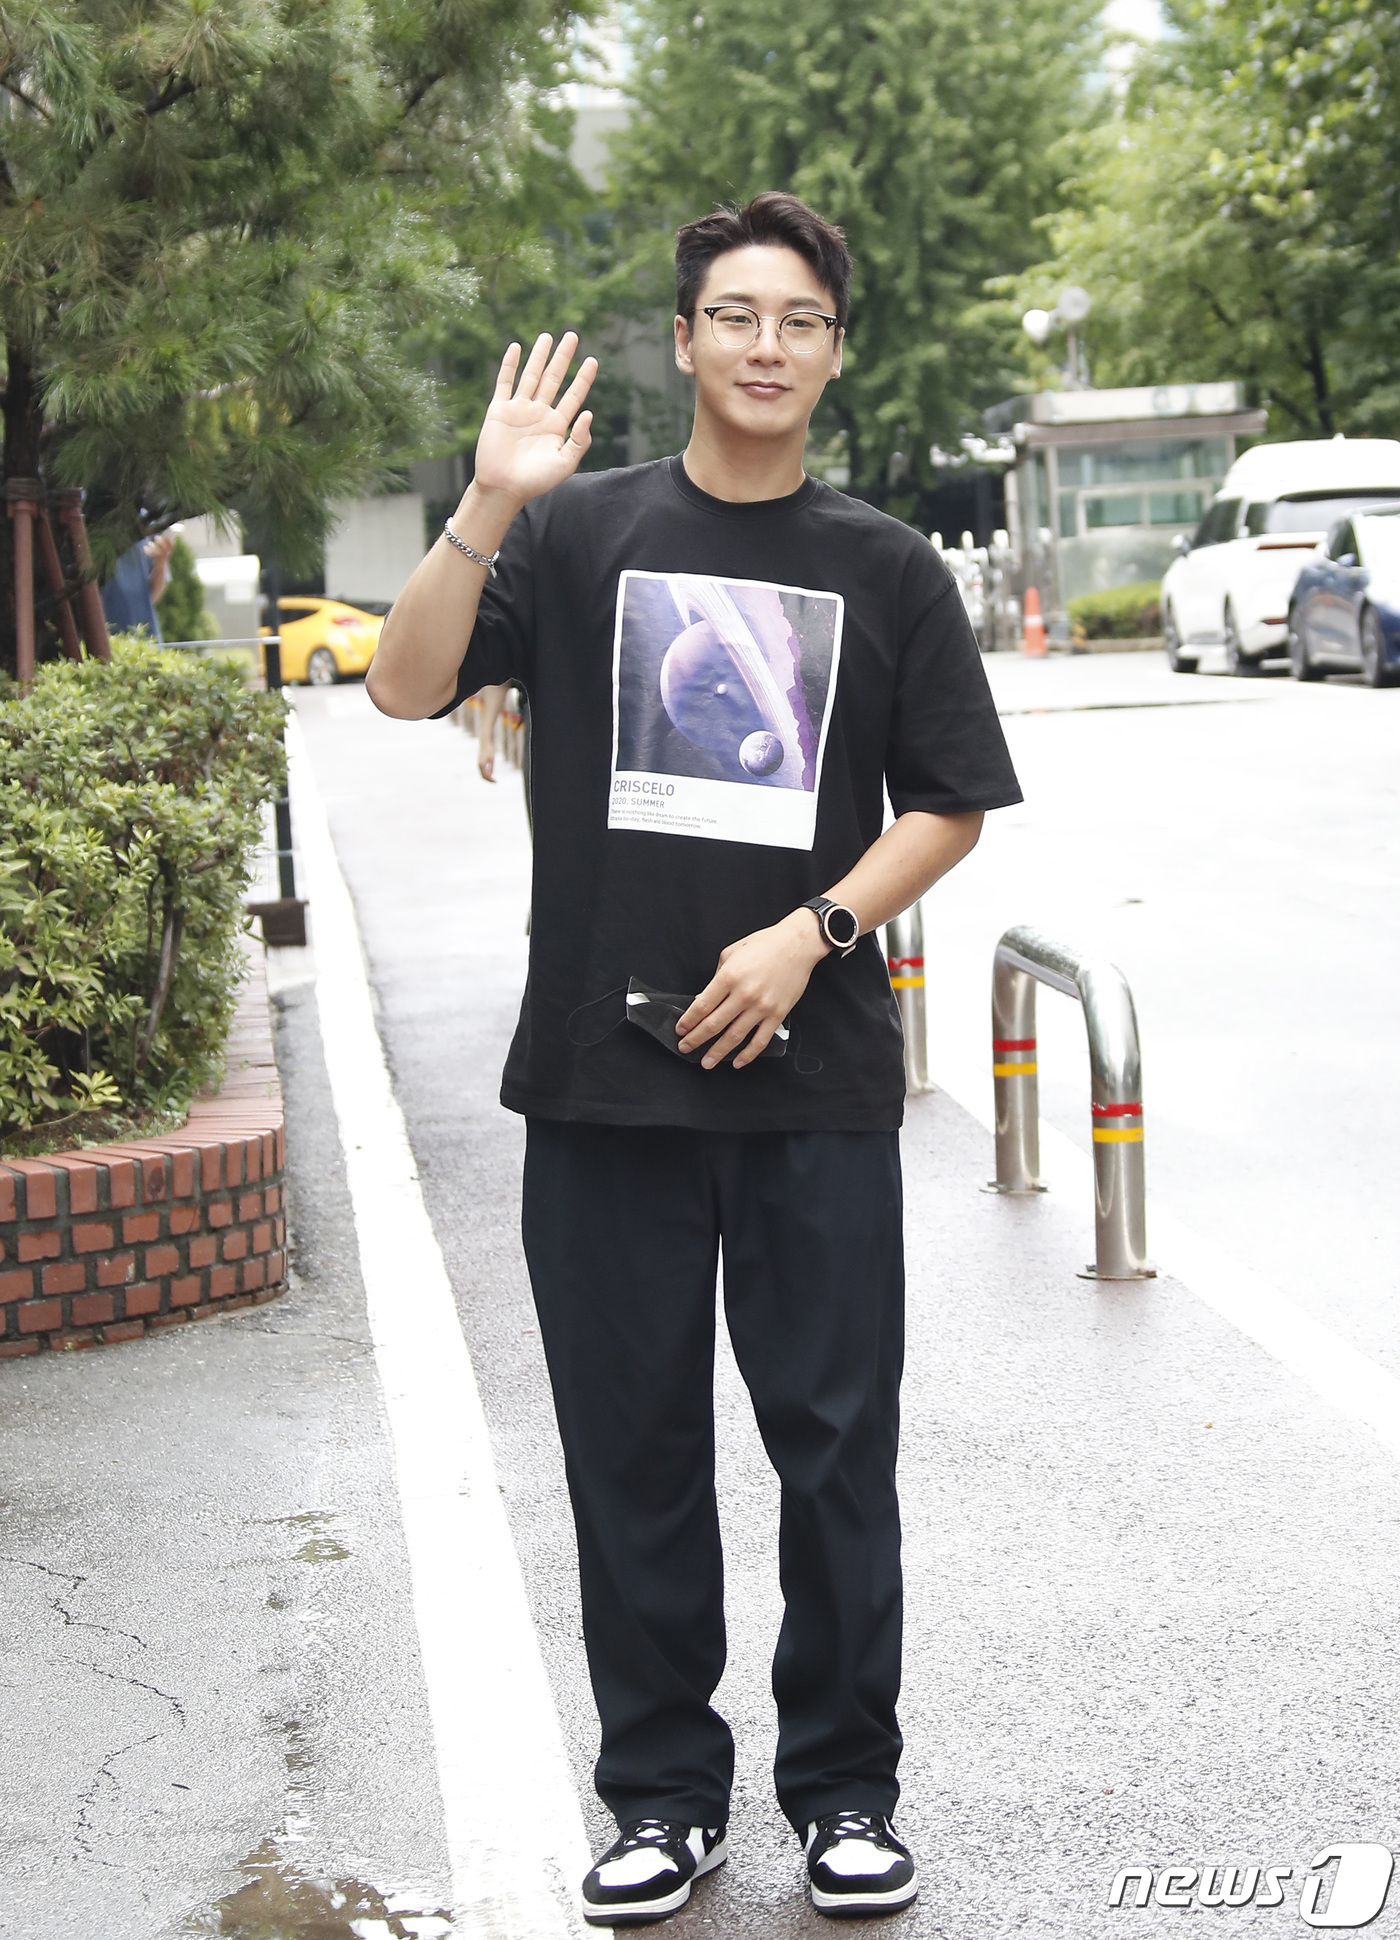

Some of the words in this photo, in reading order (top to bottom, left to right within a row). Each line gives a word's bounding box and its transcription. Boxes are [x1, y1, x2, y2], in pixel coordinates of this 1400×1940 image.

[613, 780, 675, 797] CRISCELO
[611, 797, 629, 805] 2020.
[631, 798, 665, 808] SUMMER
[626, 809, 646, 817] nothing
